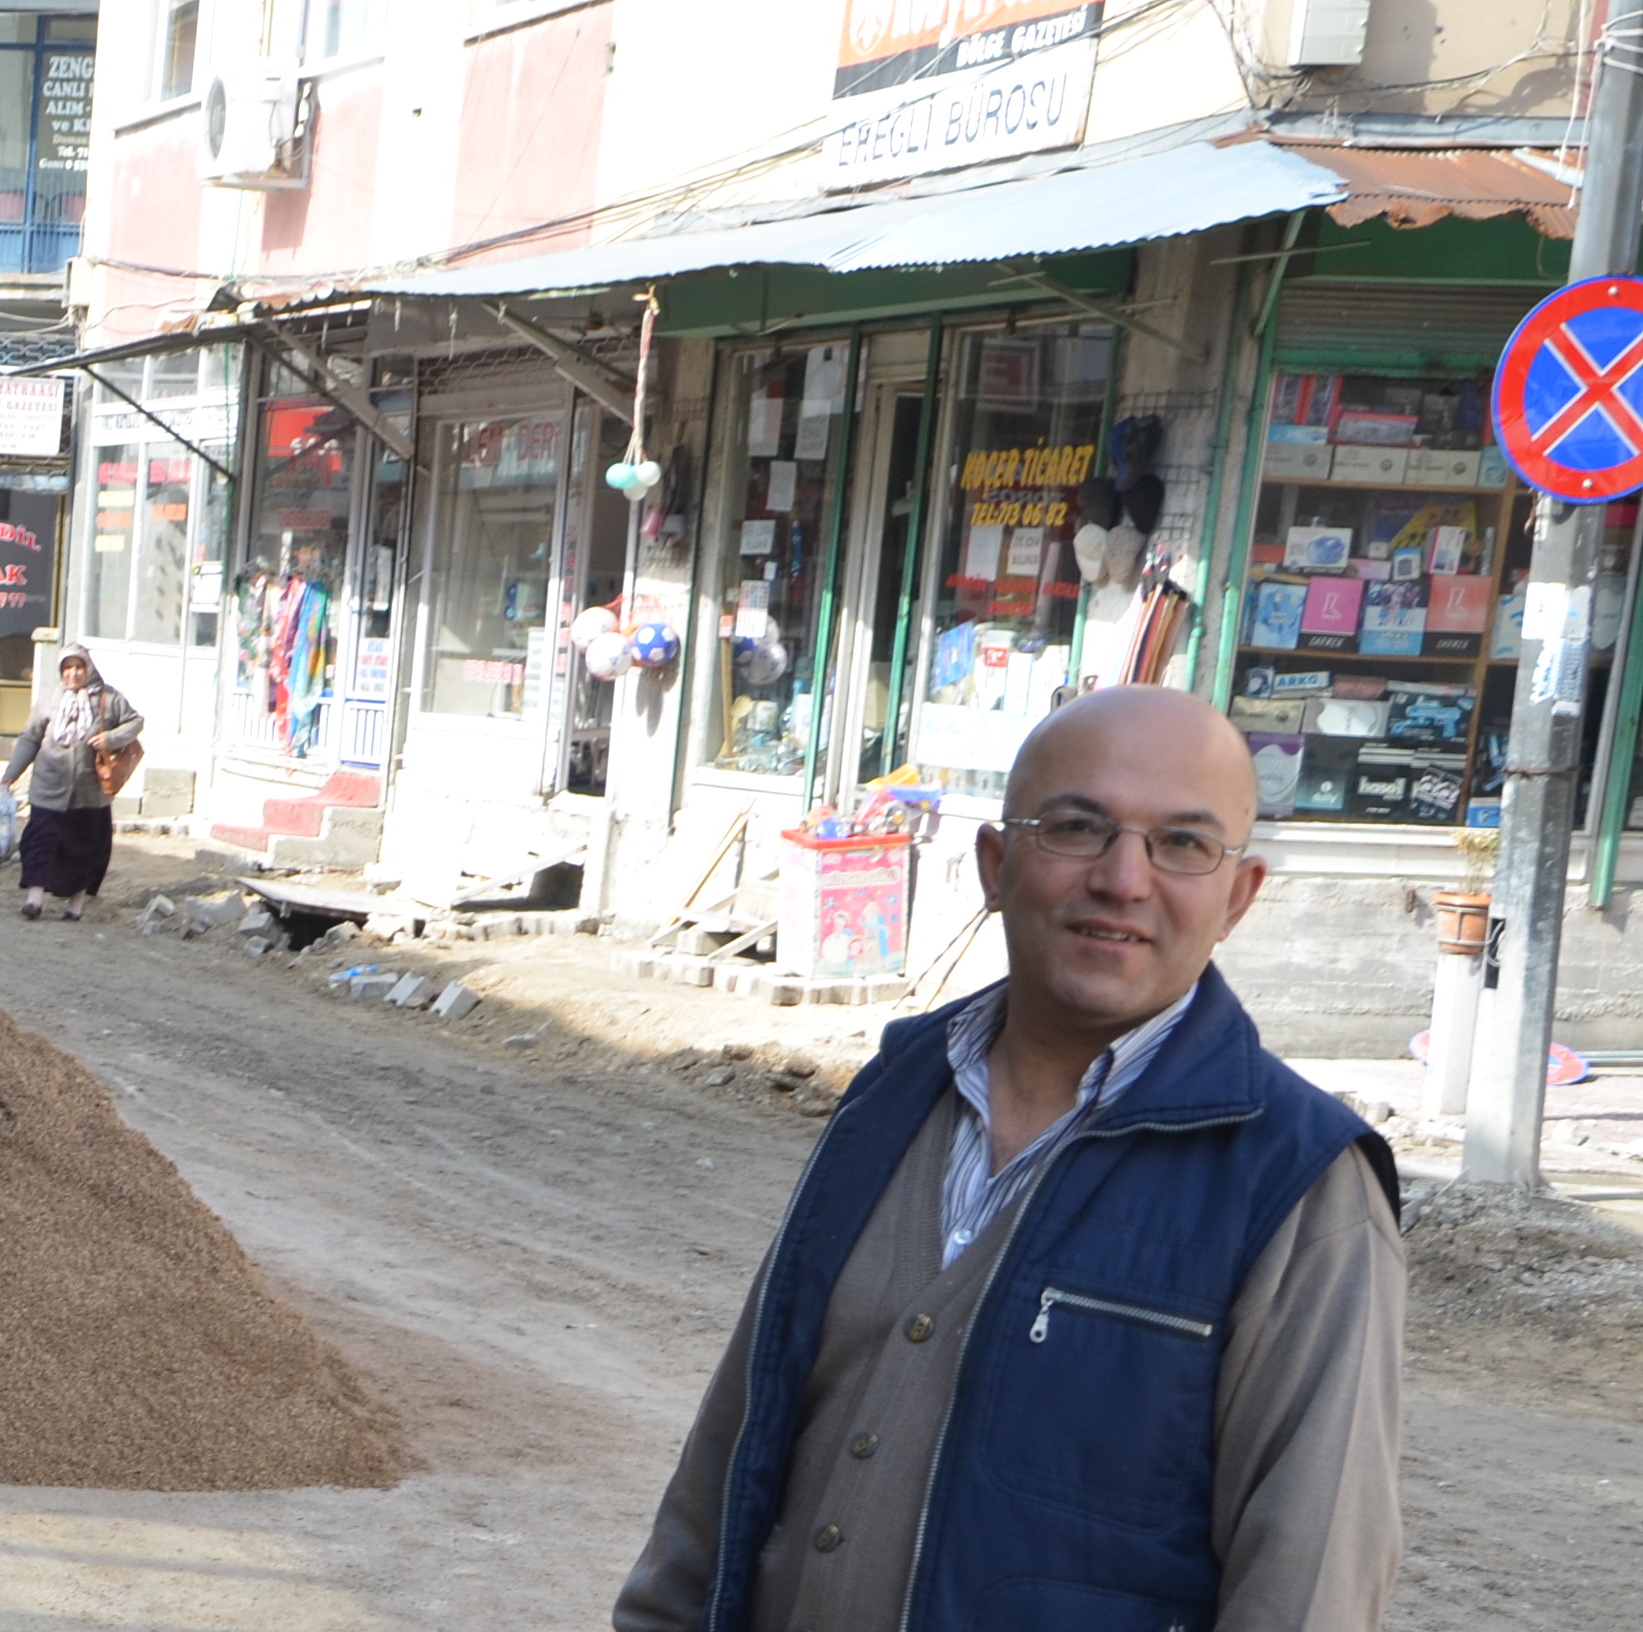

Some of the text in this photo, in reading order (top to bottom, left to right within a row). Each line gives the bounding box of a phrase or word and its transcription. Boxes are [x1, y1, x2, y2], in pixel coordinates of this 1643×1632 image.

[42, 81, 86, 97] CANLI
[45, 100, 84, 115] ALIM
[945, 73, 1067, 146] BÜROSU
[1022, 501, 1042, 526] 06
[1045, 501, 1068, 526] 82
[1276, 674, 1319, 688] ARKO
